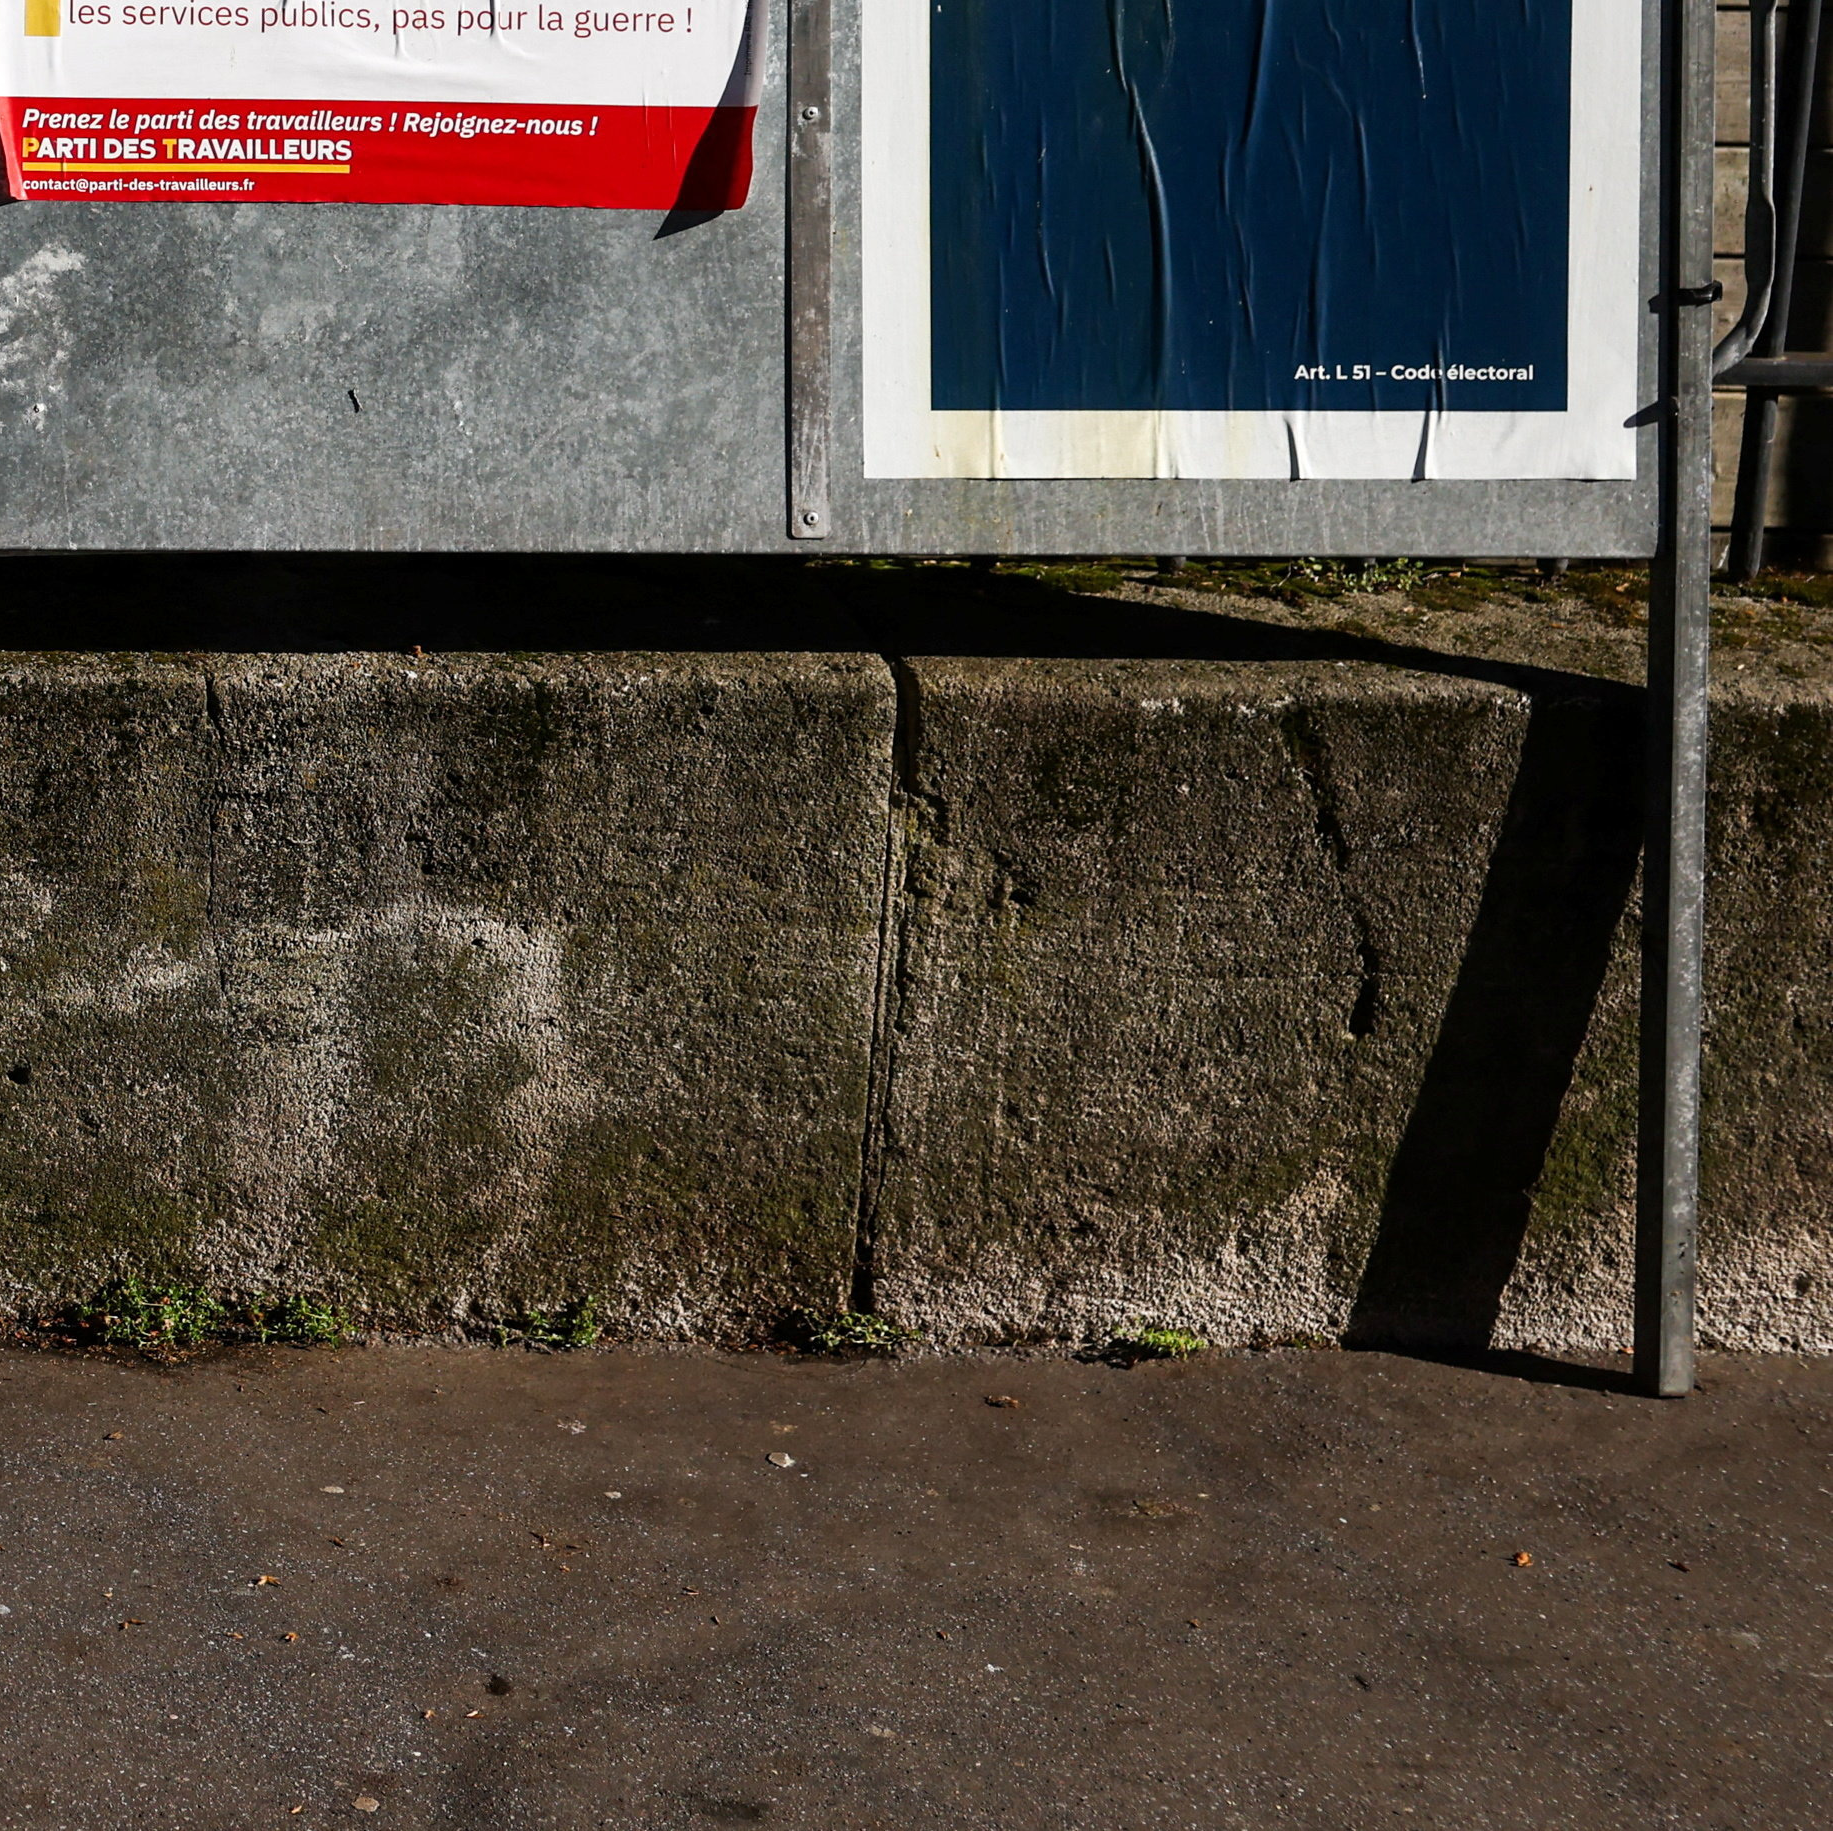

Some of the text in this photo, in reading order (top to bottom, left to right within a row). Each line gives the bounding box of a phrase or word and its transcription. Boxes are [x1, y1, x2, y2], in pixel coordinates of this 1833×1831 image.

[23, 137, 352, 160] PARTI DES TRAVAILLEURS
[23, 177, 255, 193] contact@parti-des-travailleurs.fr
[1294, 364, 1331, 380] Art.
[1336, 364, 1347, 380] L
[1352, 364, 1371, 380] 51
[1390, 364, 1443, 380] Code
[1447, 364, 1534, 380] électoral
